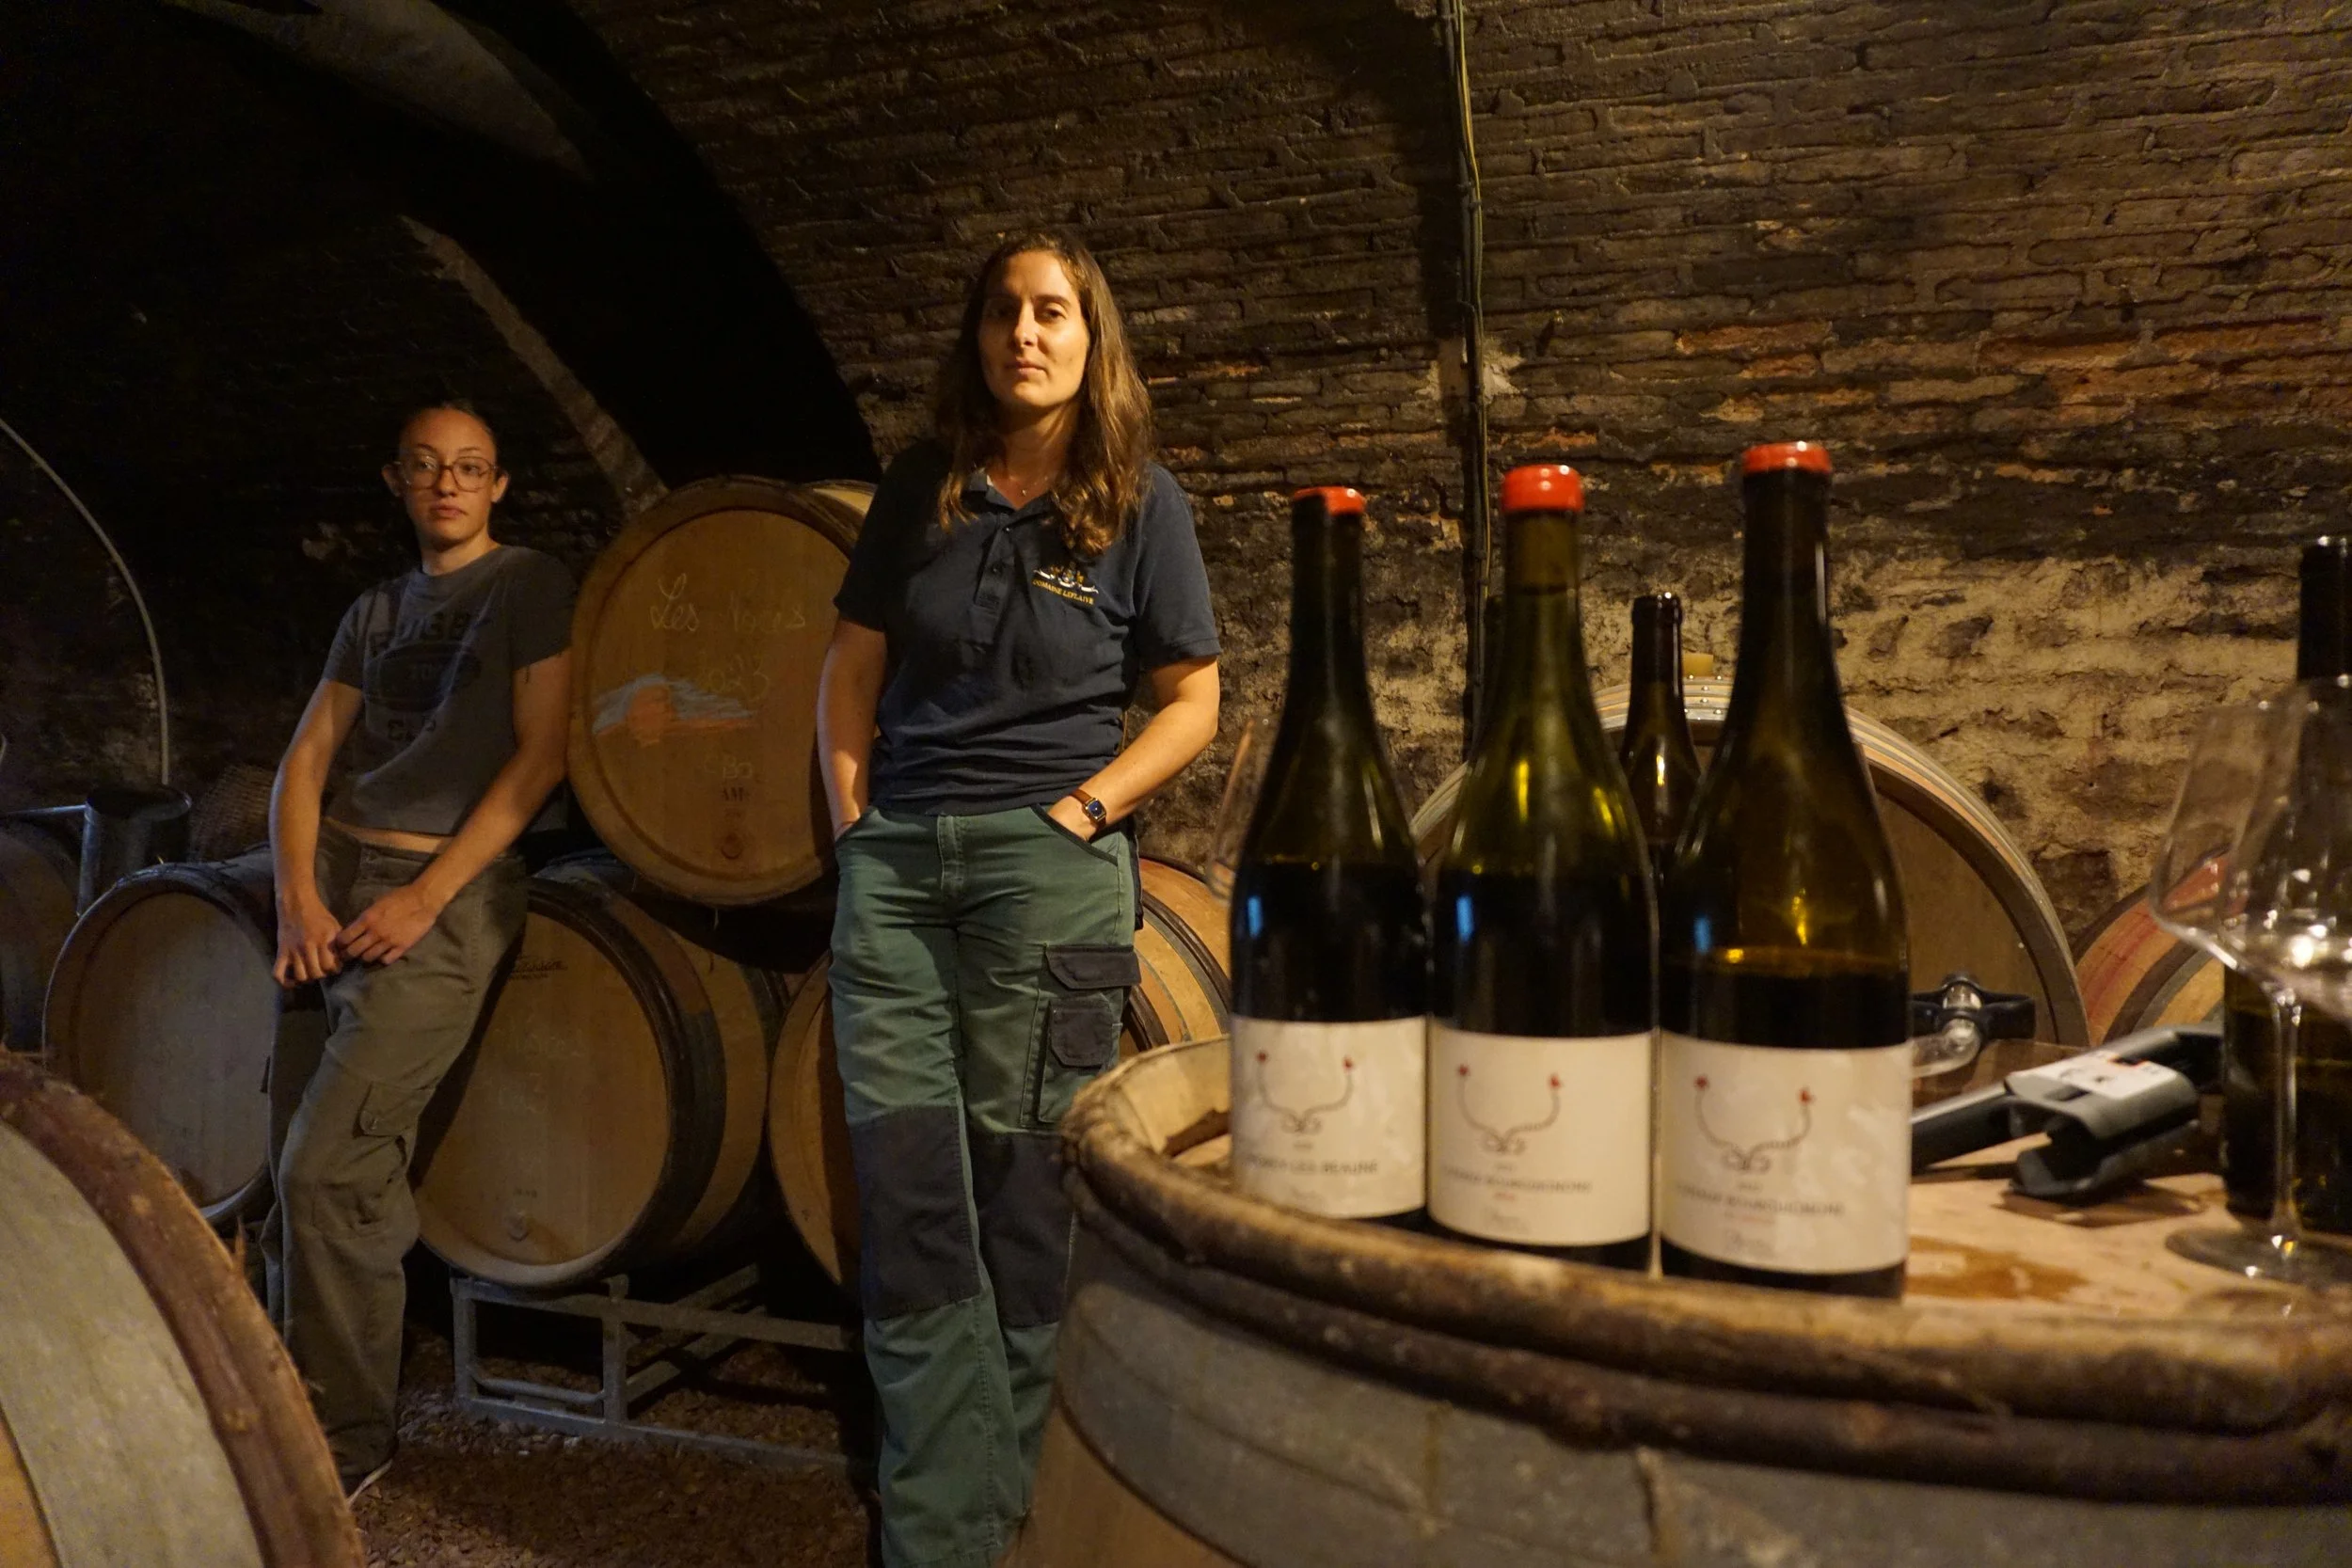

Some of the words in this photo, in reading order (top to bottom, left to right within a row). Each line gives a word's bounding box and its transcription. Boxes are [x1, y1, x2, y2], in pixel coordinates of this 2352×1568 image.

[649, 573, 700, 632] Les
[1032, 578, 1063, 595] DOMAINE
[1063, 590, 1095, 606] LEFLAIVE
